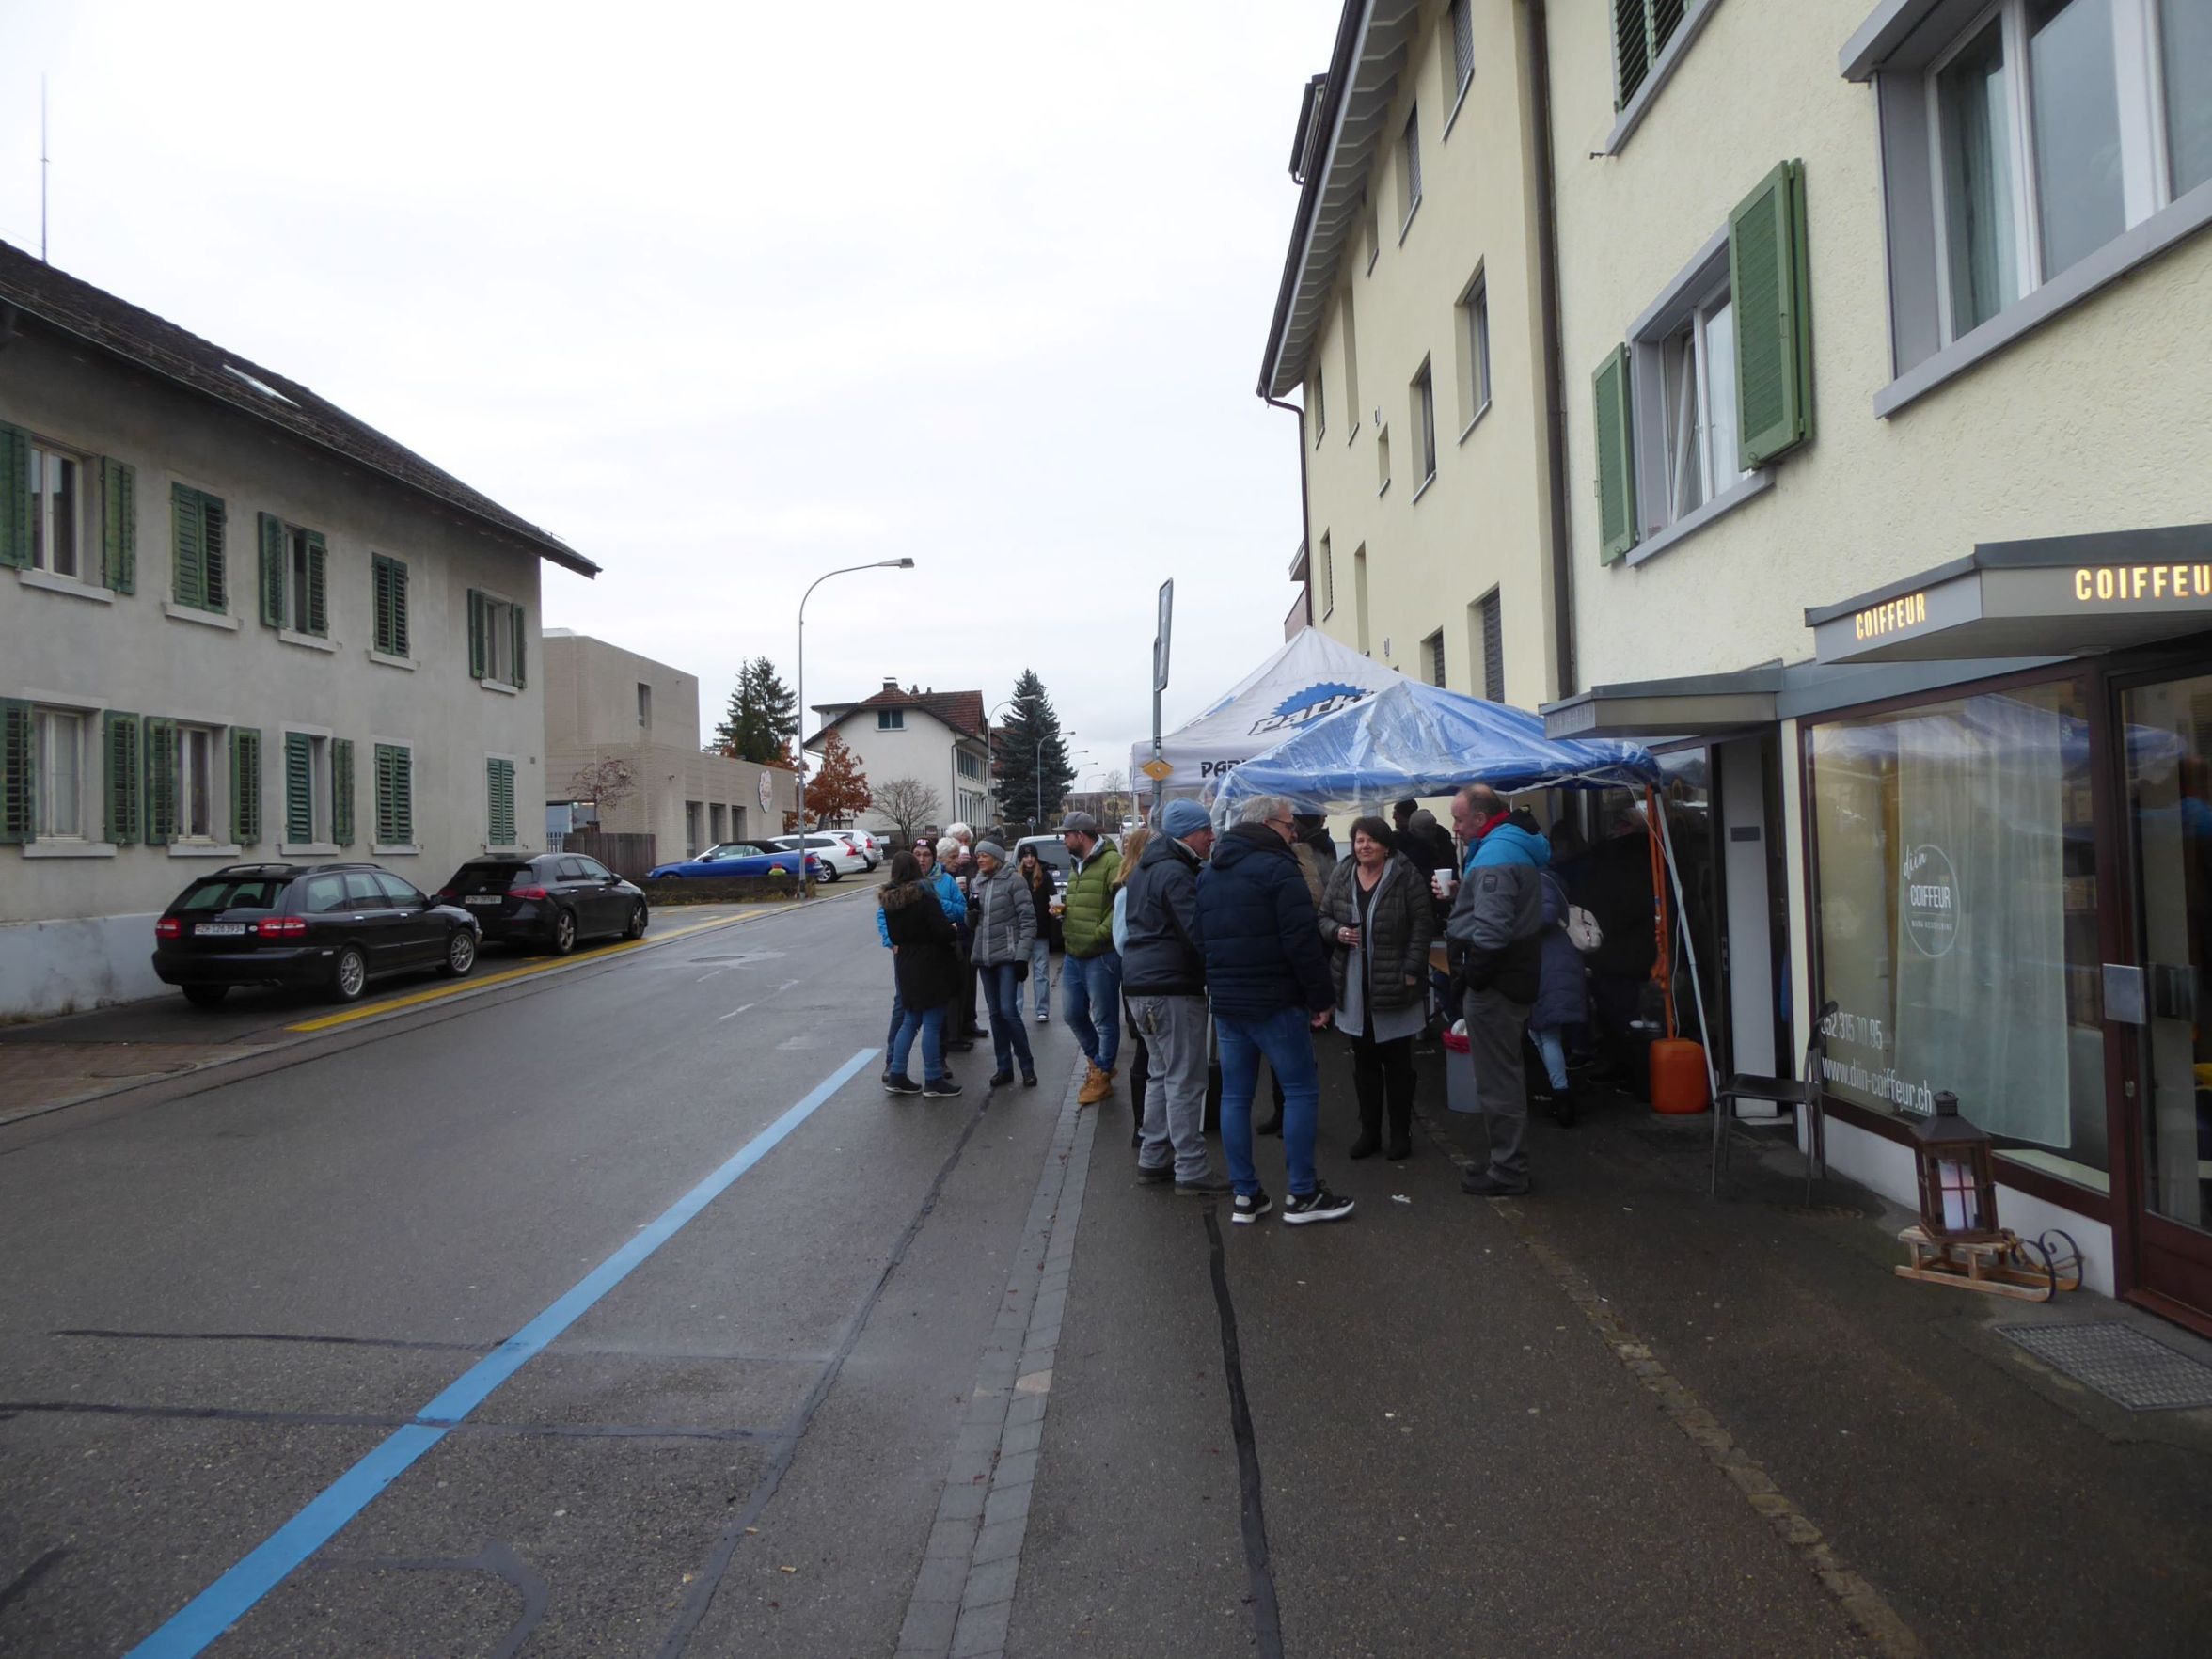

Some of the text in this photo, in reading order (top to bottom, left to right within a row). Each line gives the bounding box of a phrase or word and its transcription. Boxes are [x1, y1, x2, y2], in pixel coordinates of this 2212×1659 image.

[2074, 565, 2211, 601] COIFFEU
[1856, 592, 1926, 640] COIFFEUR
[1910, 884, 1951, 908] COIFFEUR
[1870, 1019, 1883, 1050] 95
[1822, 1056, 1933, 1114] www.diin-coiffeur.ch
